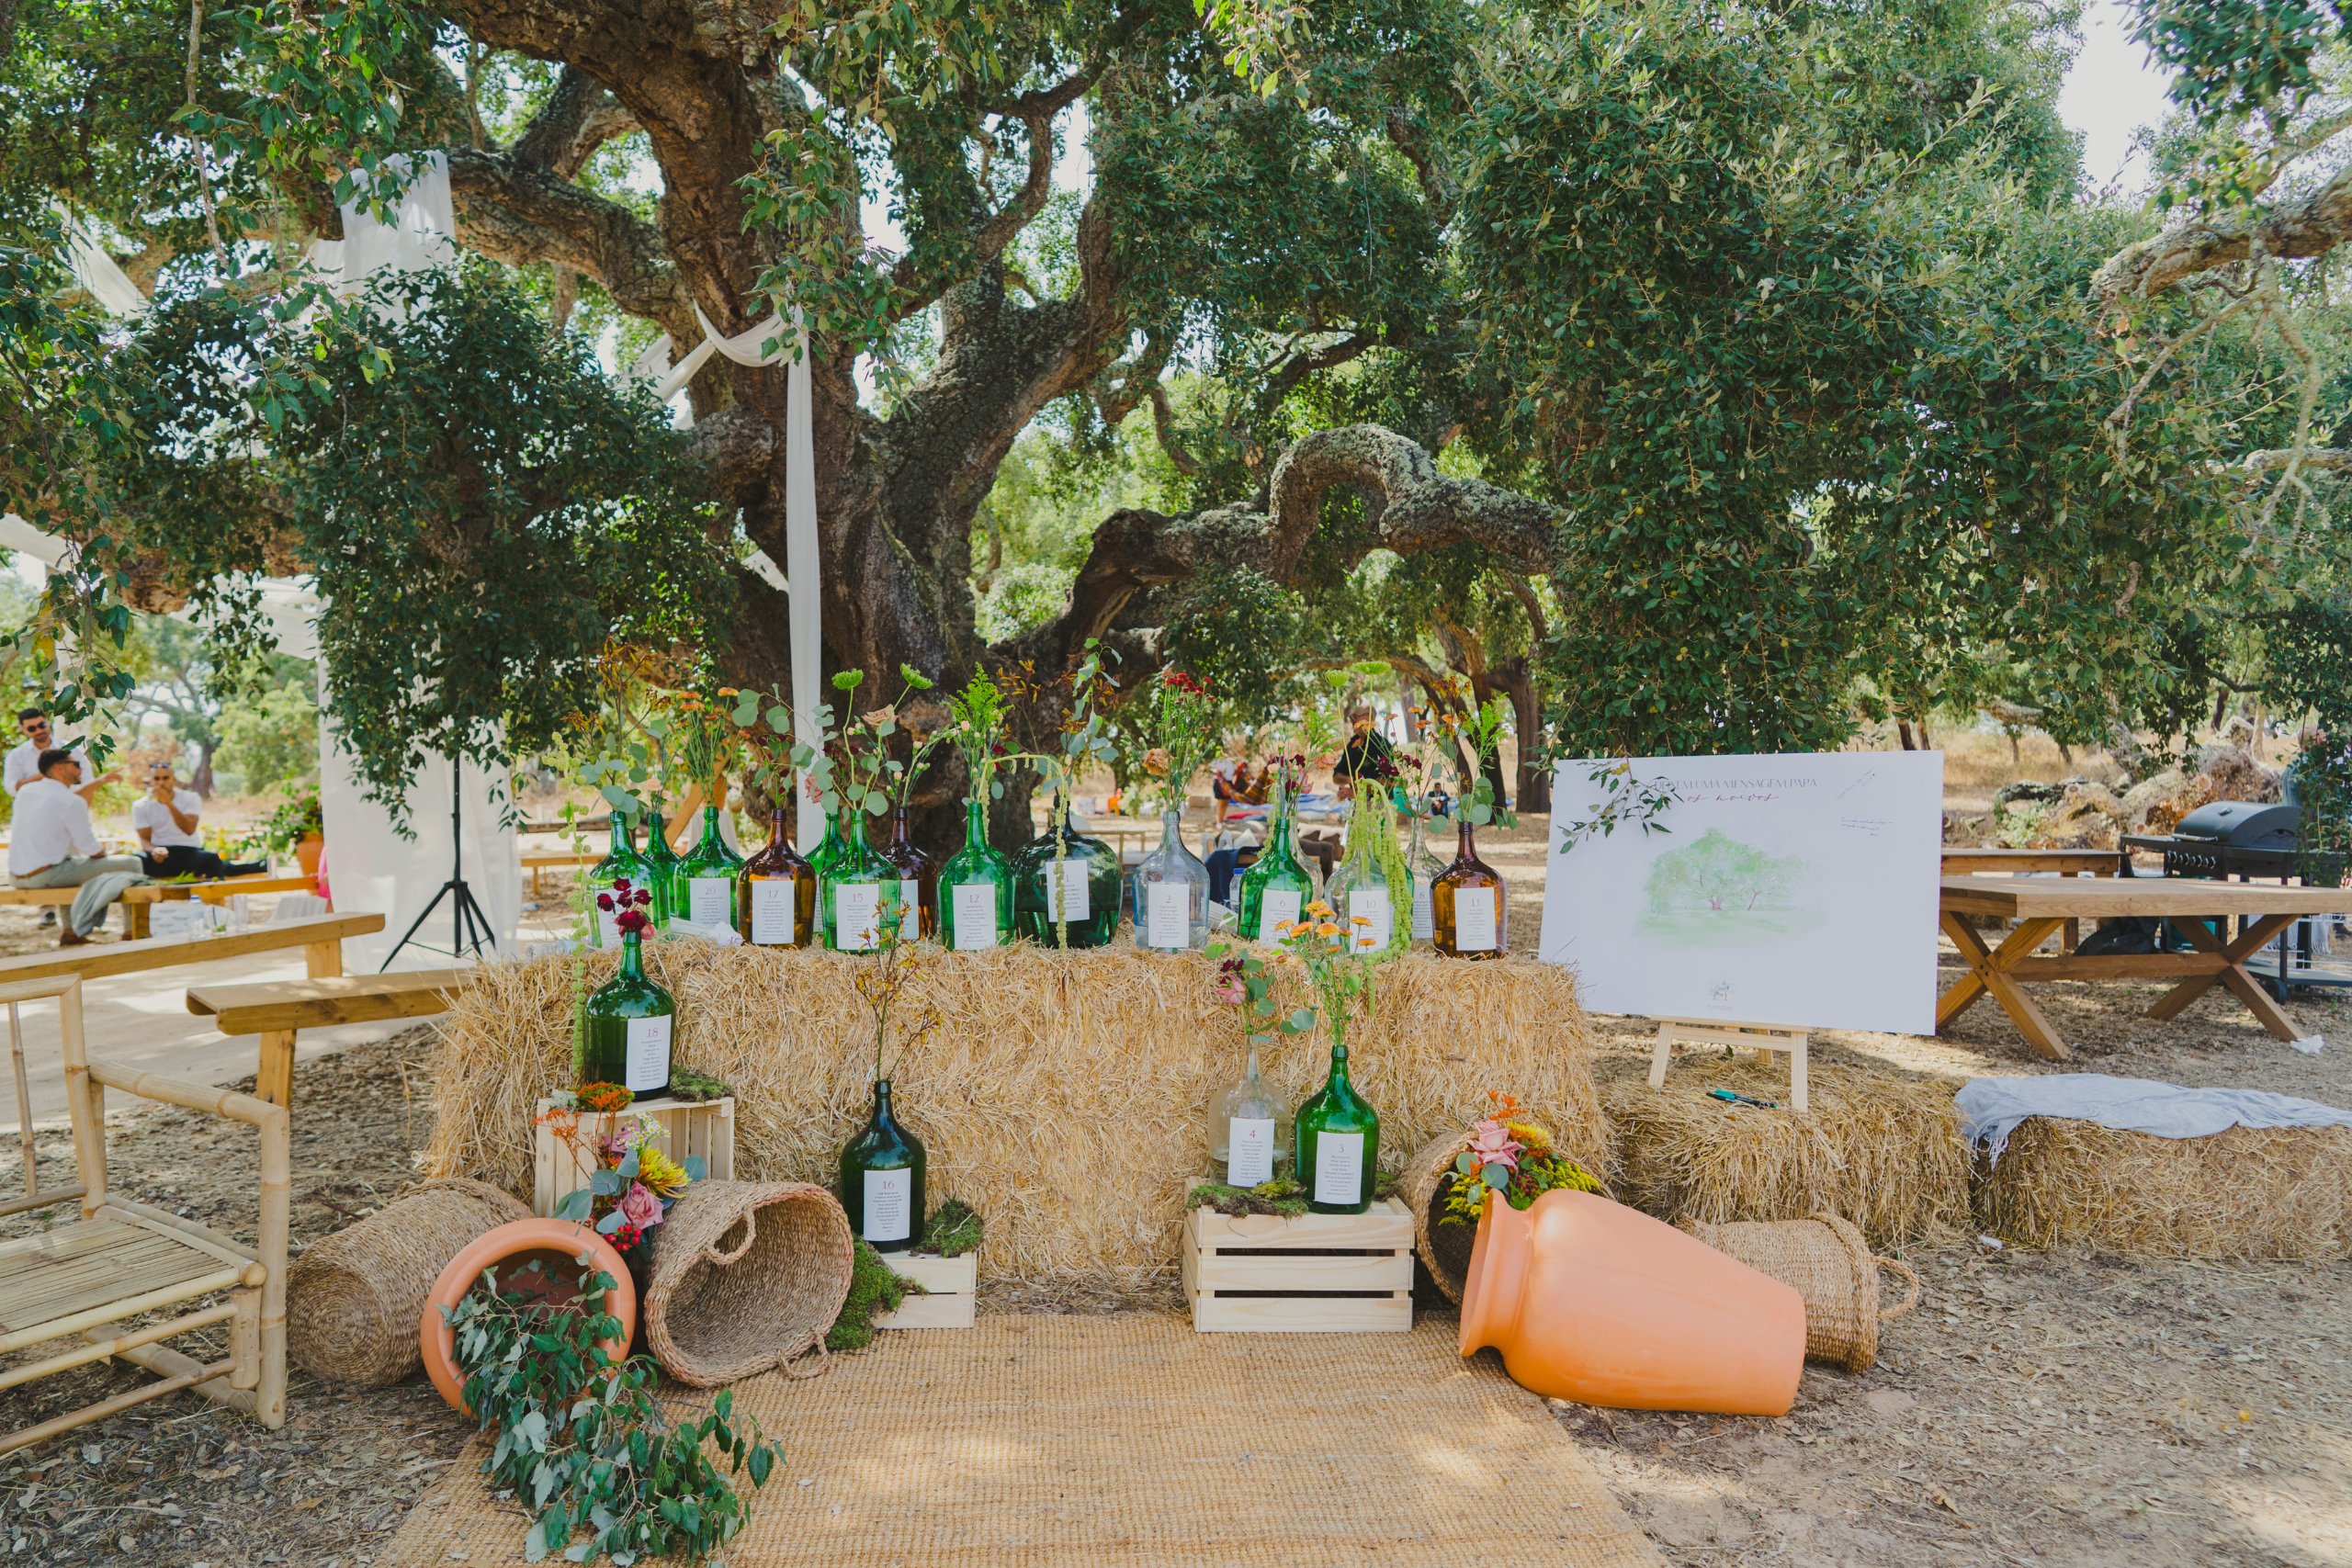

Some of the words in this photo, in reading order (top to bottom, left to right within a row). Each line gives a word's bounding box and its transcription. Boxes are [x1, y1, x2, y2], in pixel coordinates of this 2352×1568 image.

[1724, 779, 1787, 789] MENSAGEM
[705, 886, 717, 896] 20
[767, 890, 779, 898] 17
[853, 893, 864, 902] 15
[969, 894, 980, 903] 12
[1166, 895, 1171, 904] 2
[1280, 899, 1286, 908] 6
[1366, 900, 1376, 908] 10
[647, 1028, 659, 1038] 18
[1250, 1130, 1257, 1138] 4
[1338, 1143, 1344, 1154] 3
[883, 1180, 895, 1190] 16
